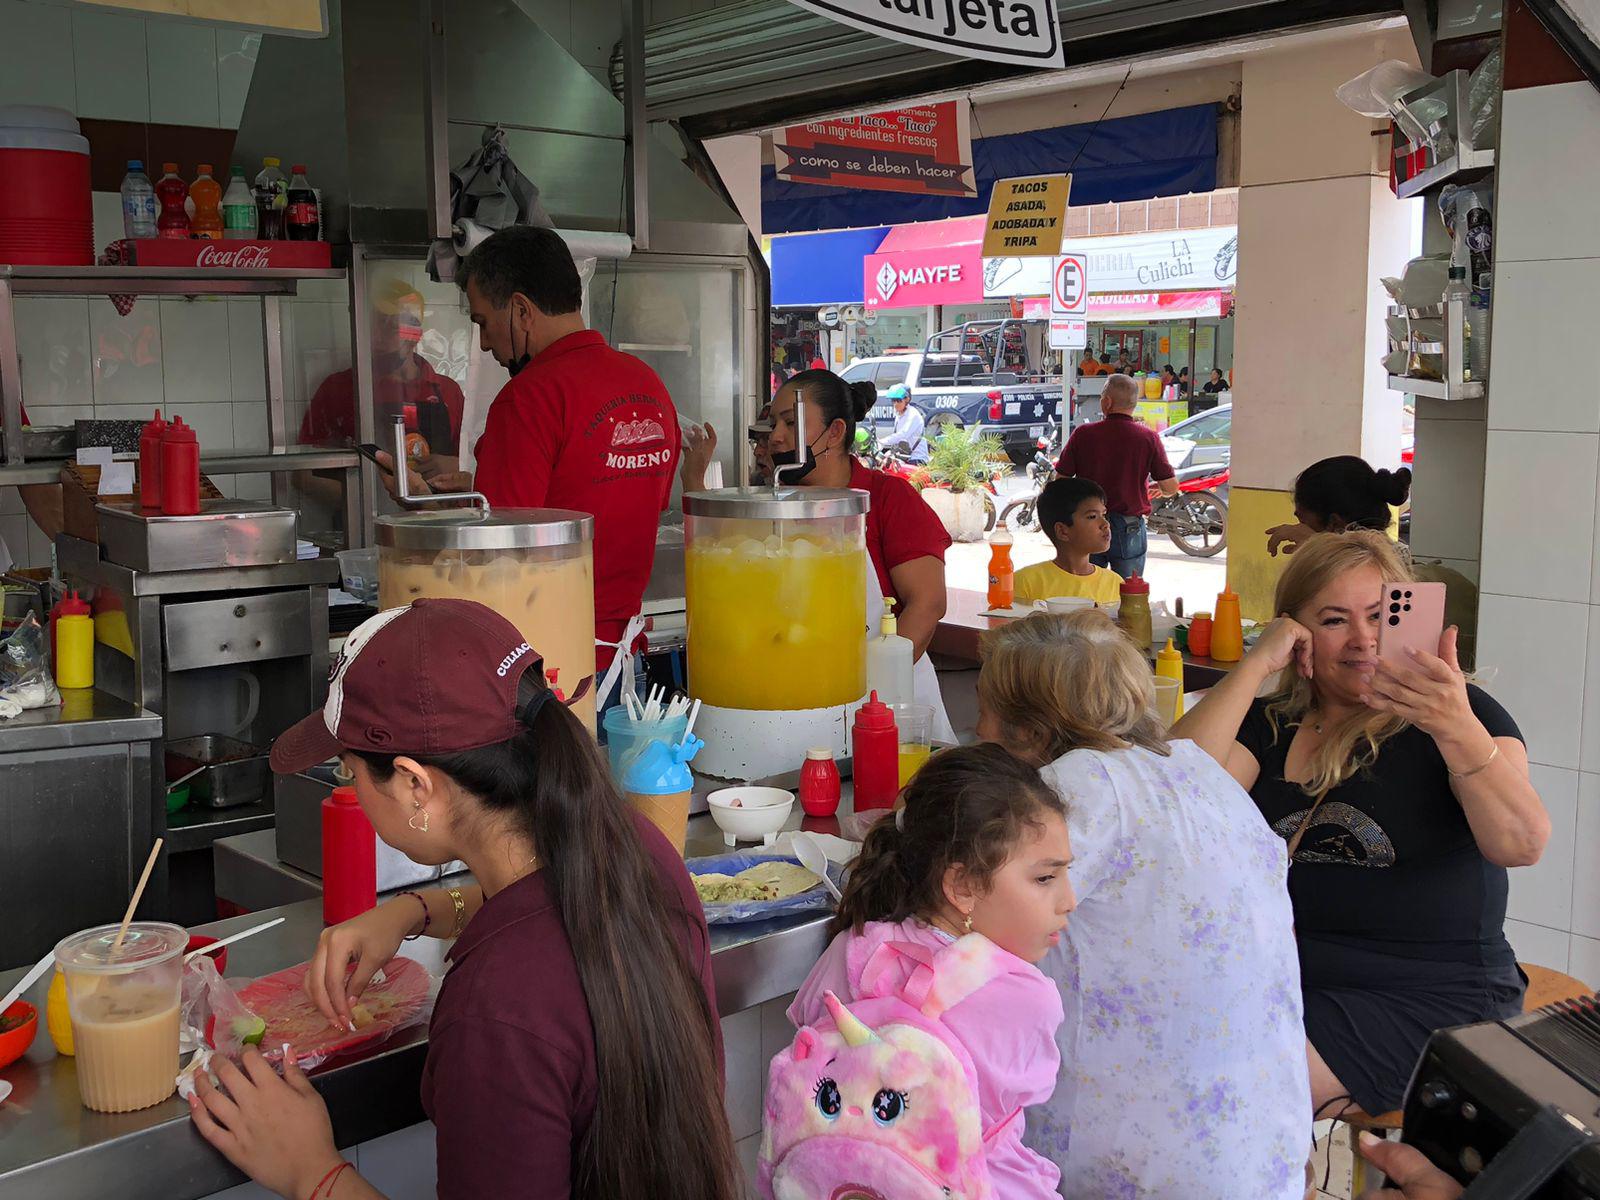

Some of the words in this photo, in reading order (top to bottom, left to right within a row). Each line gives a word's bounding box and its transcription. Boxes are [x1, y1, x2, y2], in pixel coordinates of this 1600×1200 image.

[806, 123, 826, 135] con
[828, 125, 895, 143] ingredientes
[898, 130, 938, 148] frescos
[800, 156, 839, 169] como
[846, 160, 861, 171] se
[868, 156, 911, 174] deben
[916, 159, 957, 178] hacer
[1011, 181, 1048, 194] TACOS
[1006, 200, 1047, 213] ASADA,
[992, 217, 1045, 231] ADOBADA
[1049, 217, 1057, 228] Y
[1003, 236, 1038, 247] TRIPA
[1171, 238, 1191, 258] LA
[196, 245, 273, 268] Coca-Cola
[898, 264, 961, 286] MAYFE
[1137, 257, 1195, 286] Culichi
[1064, 266, 1076, 302] E
[935, 395, 959, 409] 0306
[605, 449, 671, 470] MORENO
